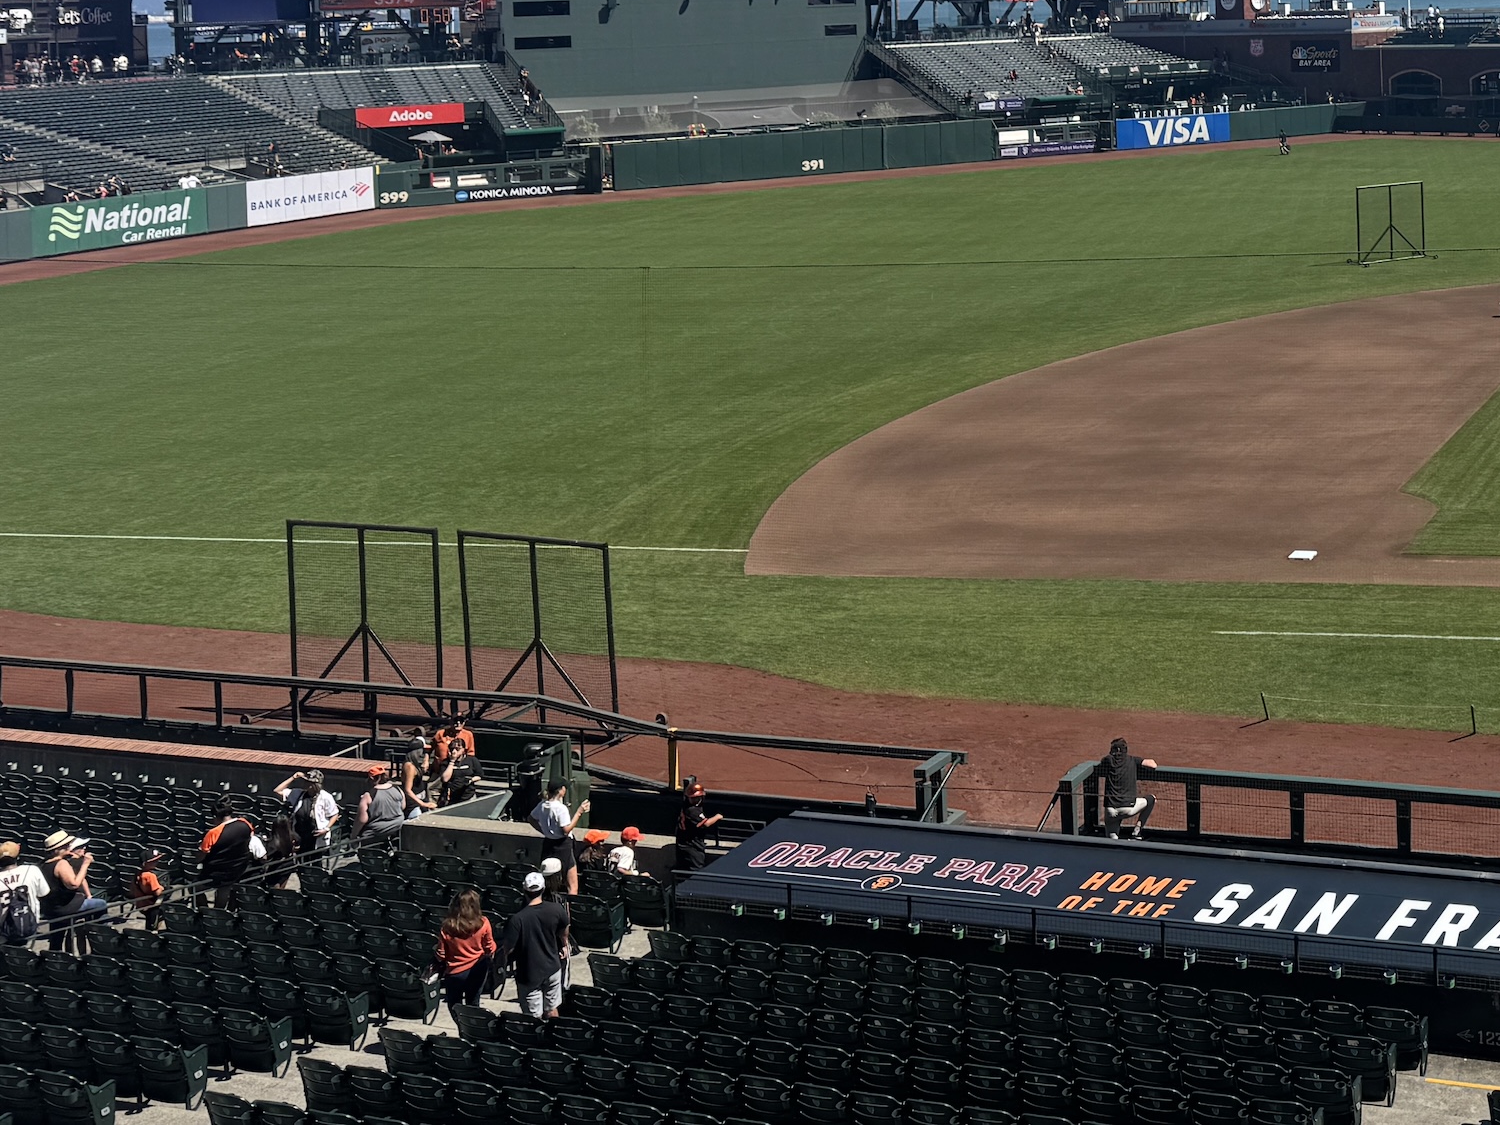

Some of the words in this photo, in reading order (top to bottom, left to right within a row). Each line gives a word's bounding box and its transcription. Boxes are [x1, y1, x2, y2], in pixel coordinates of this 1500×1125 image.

[81, 7, 112, 25] Coffee
[1306, 46, 1338, 60] Sports
[388, 107, 434, 123] Adobe
[1138, 116, 1210, 146] VISA
[801, 159, 826, 171] 391
[250, 199, 281, 211] BANK
[284, 197, 298, 206] OF
[300, 190, 348, 204] AMERICA
[380, 191, 408, 204] 399
[469, 188, 508, 200] KONICA
[509, 185, 552, 197] MINOLTA
[84, 197, 190, 233] National
[122, 231, 144, 243] Car
[146, 223, 187, 240] Rental
[748, 841, 938, 873] ORACLE
[933, 857, 1064, 897] PARK
[4, 874, 20, 885] RAY
[1082, 871, 1196, 899] HOME
[1058, 895, 1097, 911] OF
[1110, 899, 1176, 919] THE
[1193, 882, 1359, 935] SAN
